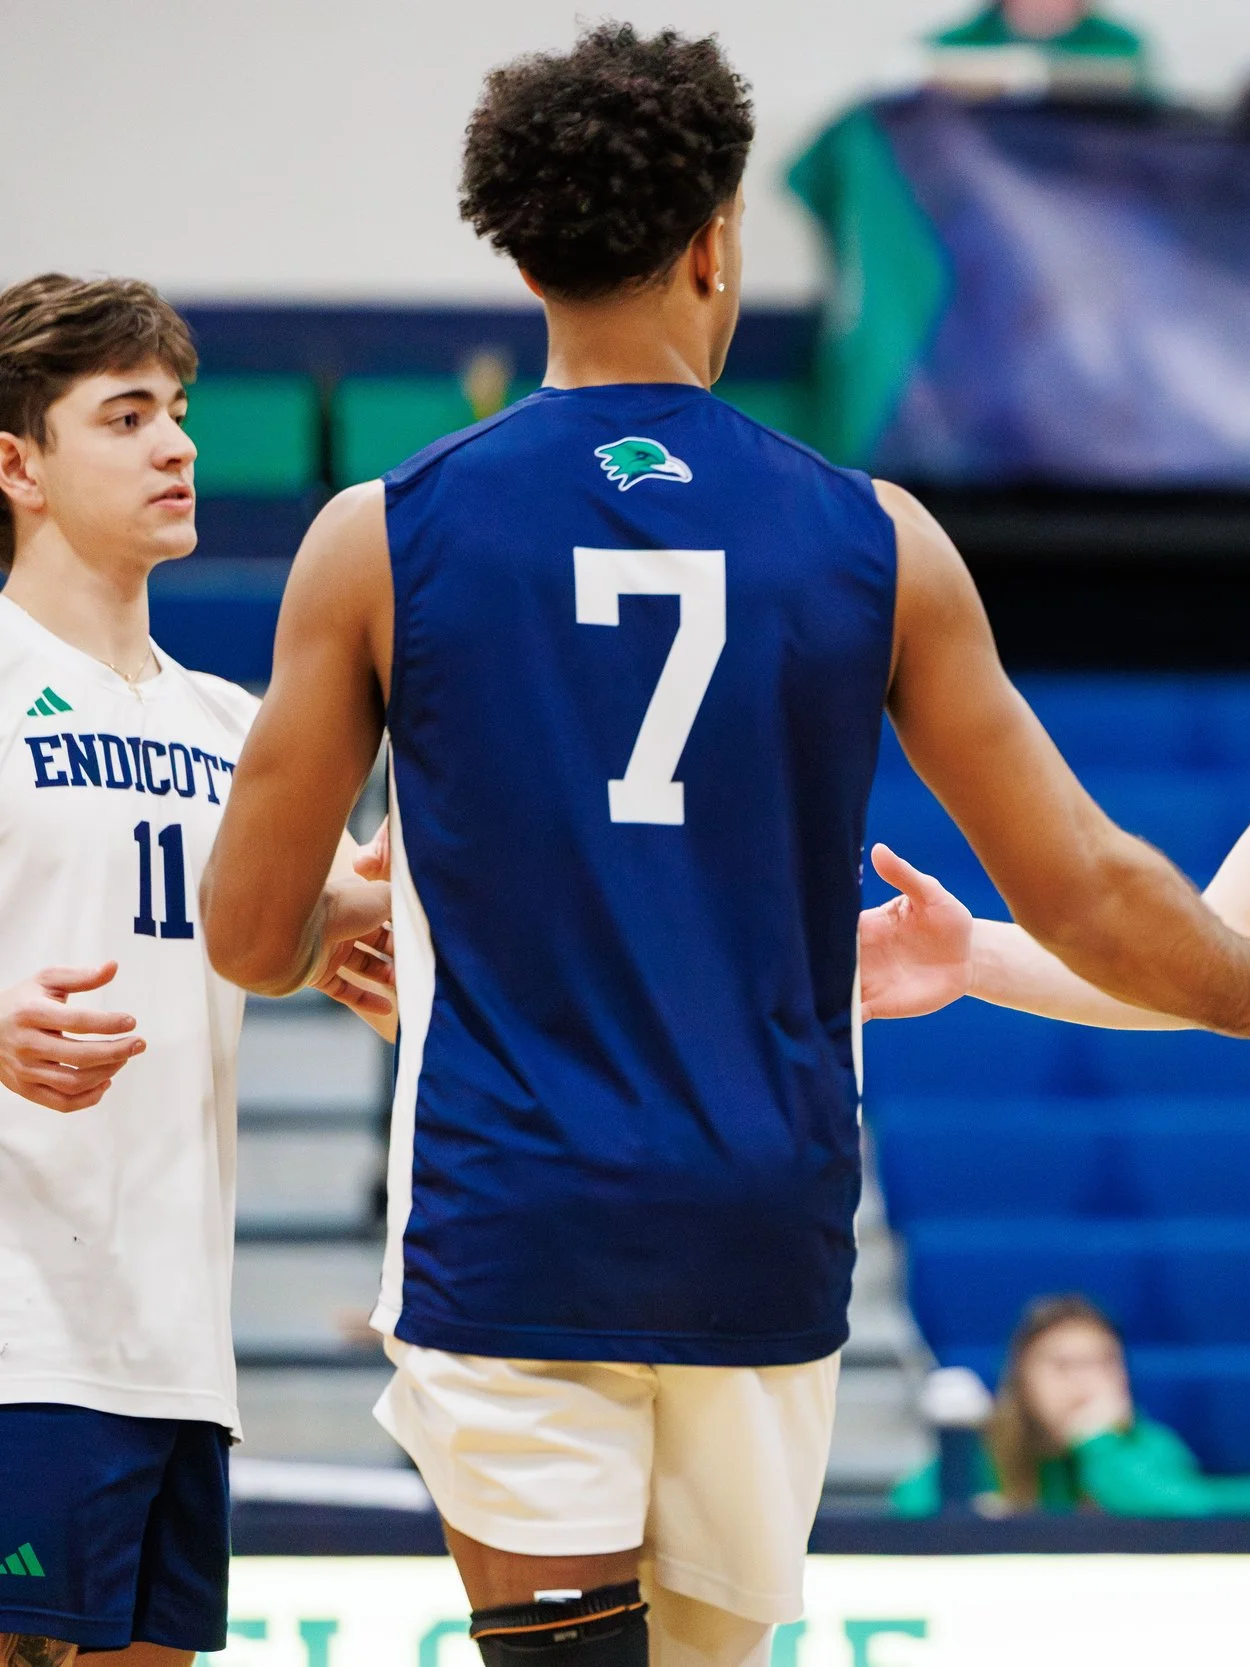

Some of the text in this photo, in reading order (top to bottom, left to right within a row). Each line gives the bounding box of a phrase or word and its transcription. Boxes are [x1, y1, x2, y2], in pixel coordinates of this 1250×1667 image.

[573, 546, 726, 826] 7
[24, 733, 236, 805] ENDICOT
[133, 820, 194, 939] 11
